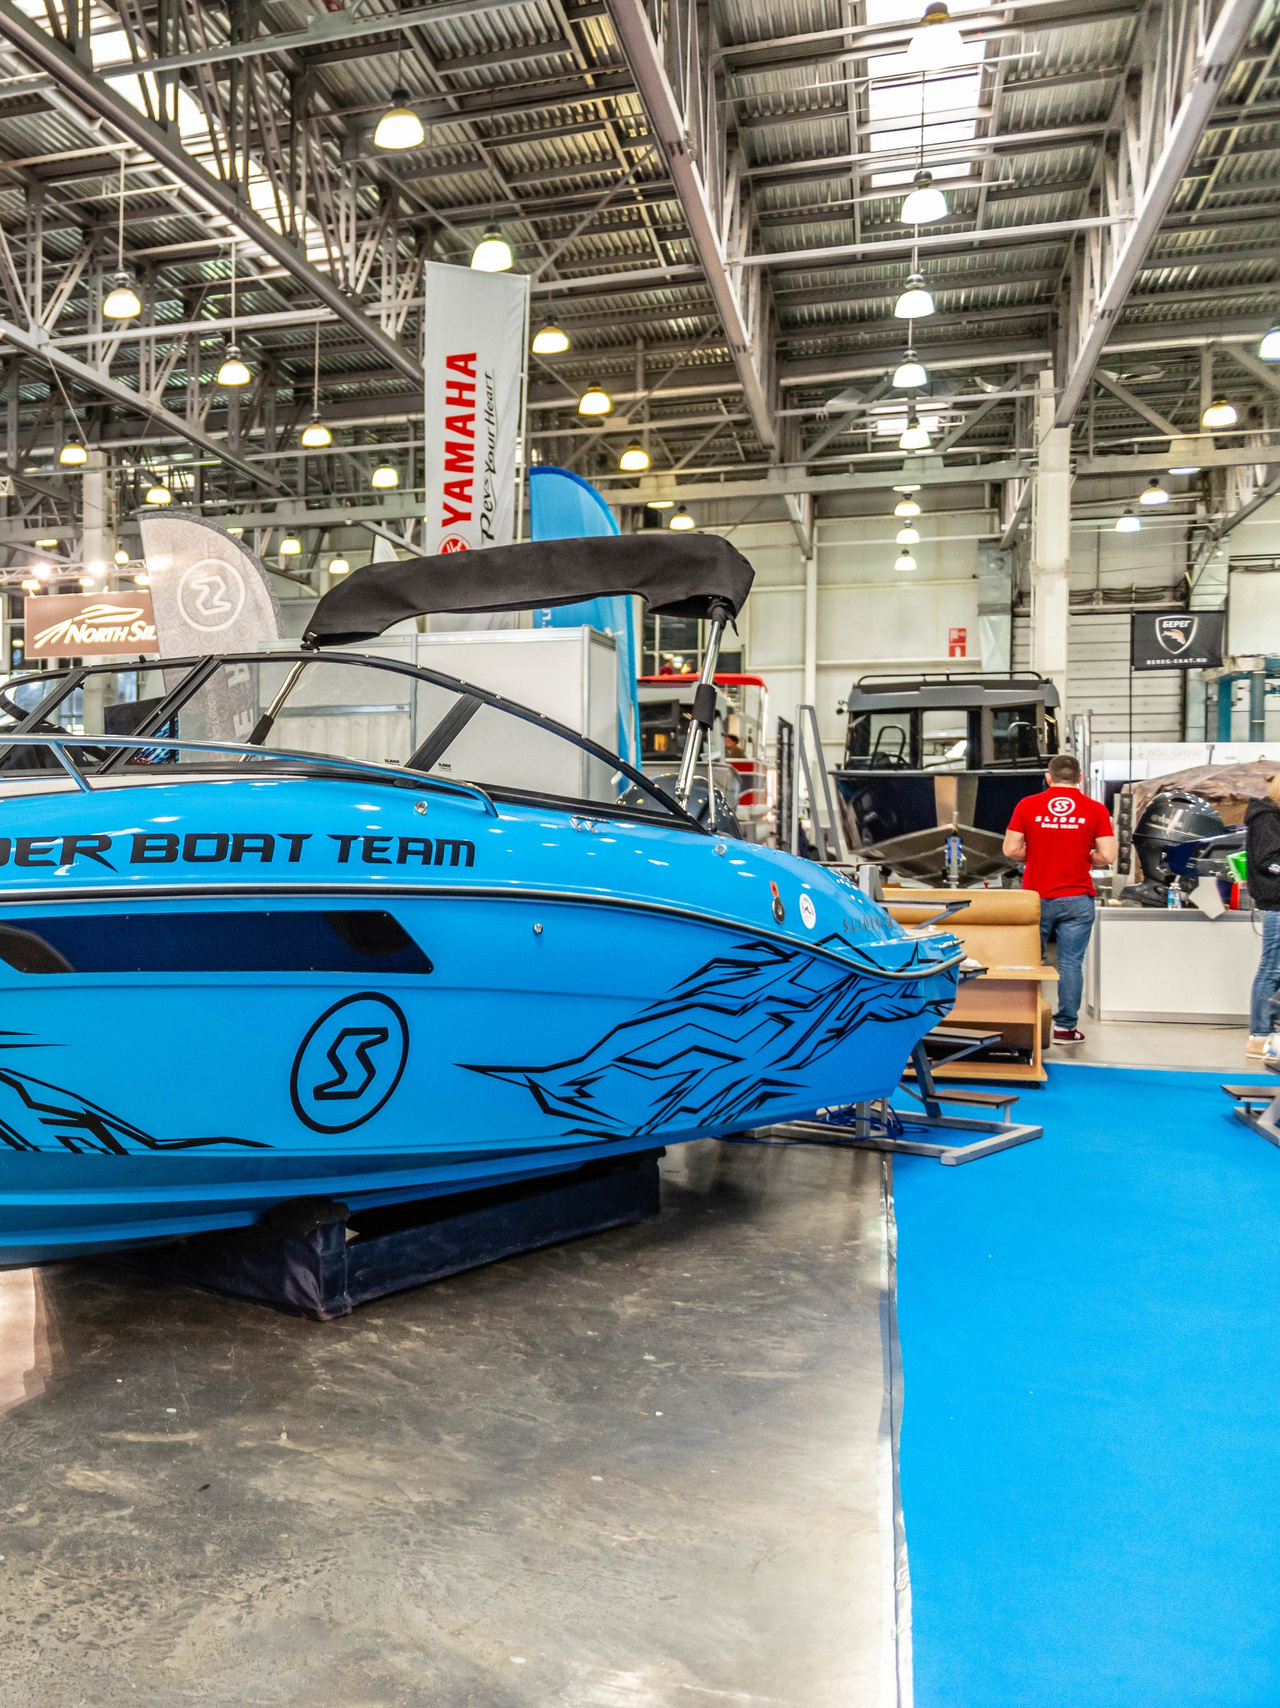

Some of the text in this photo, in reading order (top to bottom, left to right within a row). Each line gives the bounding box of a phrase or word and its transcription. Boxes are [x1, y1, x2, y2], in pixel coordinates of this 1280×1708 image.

[441, 352, 477, 528] YAMAHA
[480, 371, 496, 543] Revs Your Heart
[1162, 620, 1192, 629] БЕРЕГ
[1034, 815, 1086, 824] SLIDER
[130, 833, 314, 865] BOAT
[327, 834, 476, 867] TEAM
